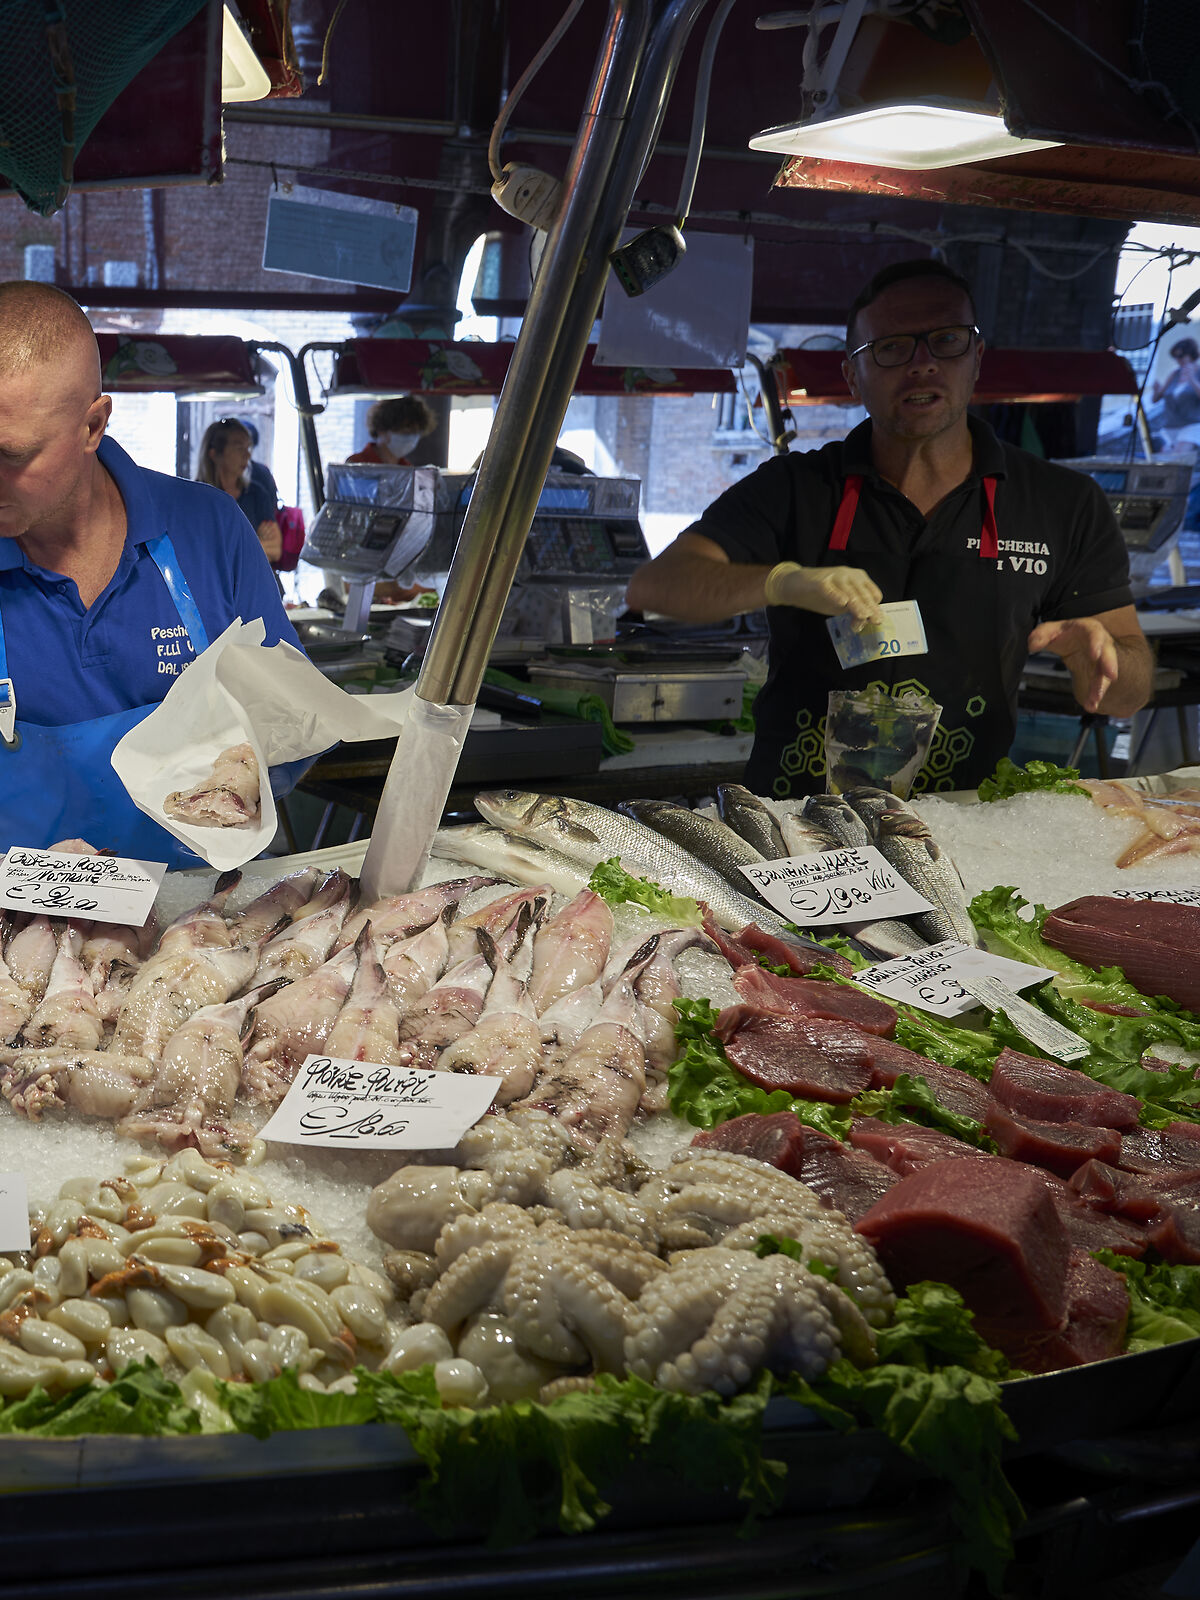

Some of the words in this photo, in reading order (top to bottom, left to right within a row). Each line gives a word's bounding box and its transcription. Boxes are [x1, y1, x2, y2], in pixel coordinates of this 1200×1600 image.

[966, 538, 1050, 555] PCHERIA
[1009, 556, 1048, 575] VIO
[878, 639, 901, 656] 20
[157, 661, 179, 676] DAL
